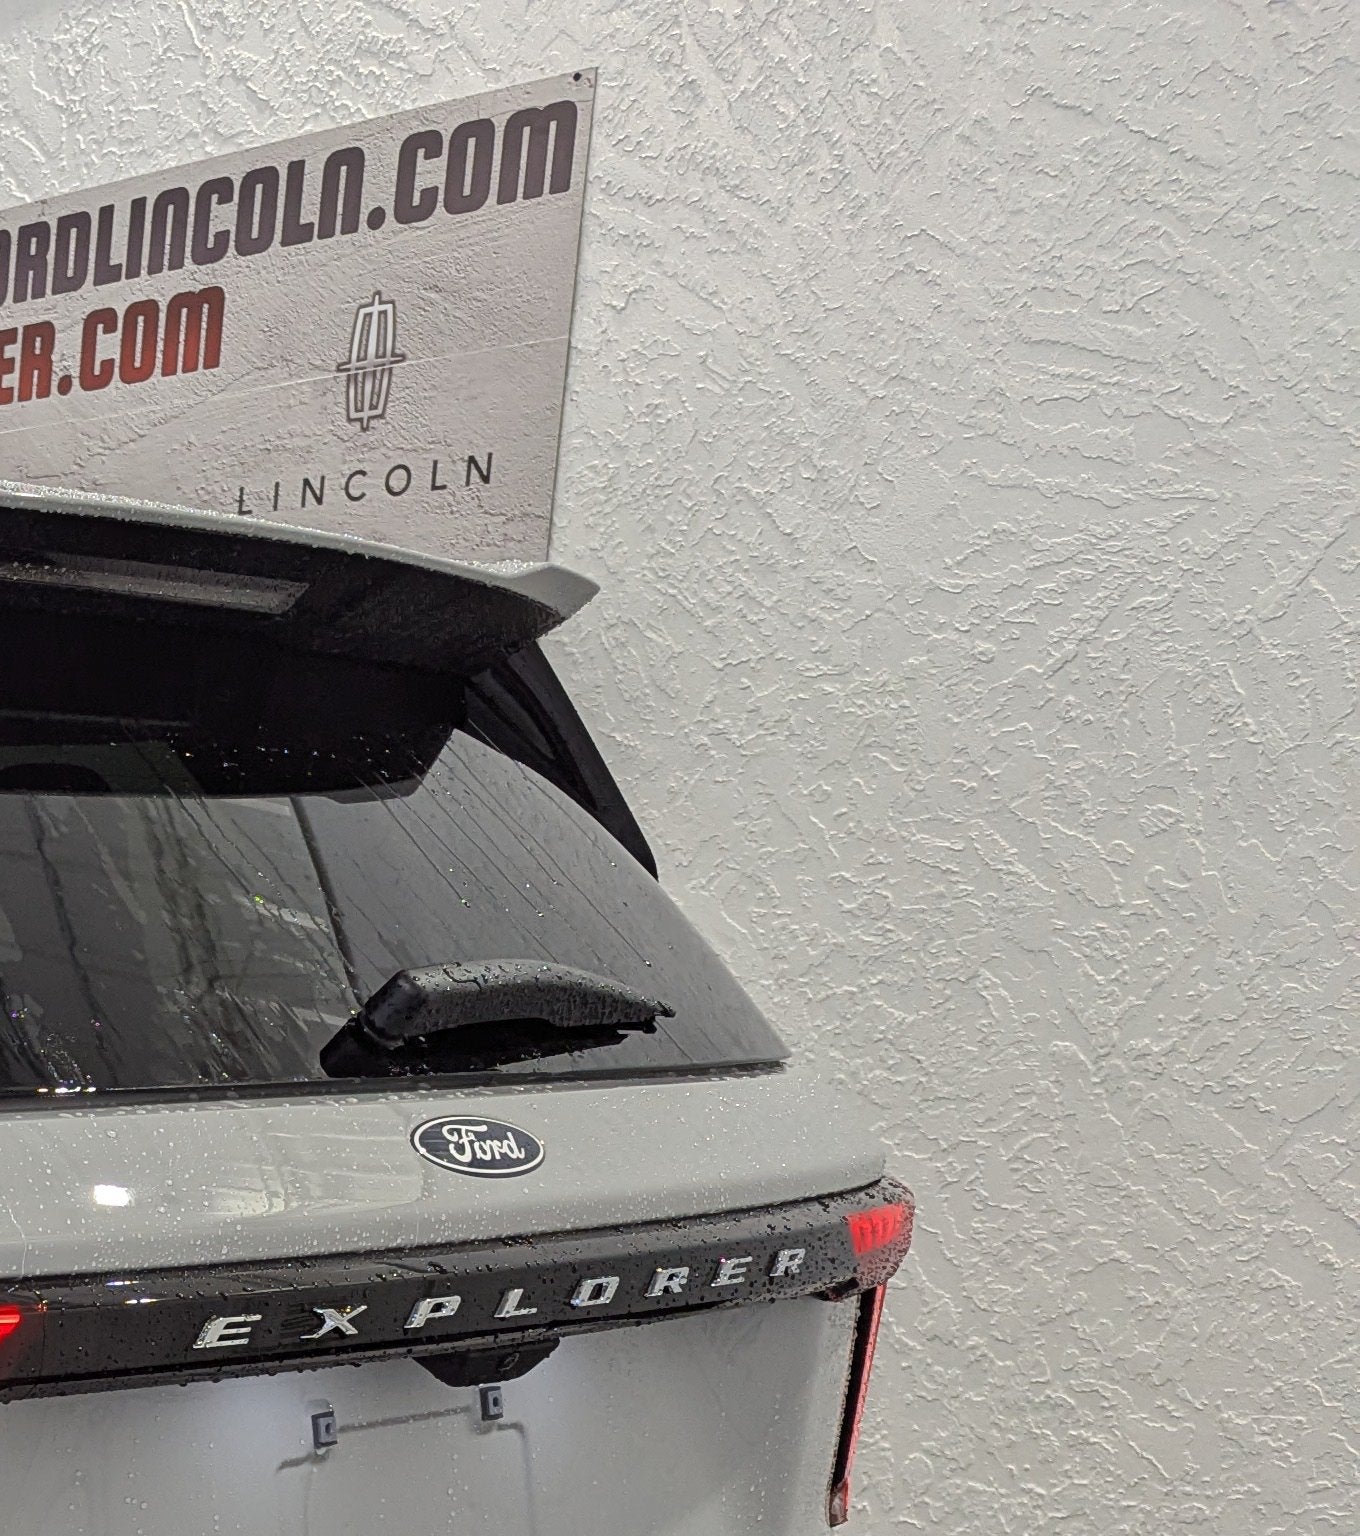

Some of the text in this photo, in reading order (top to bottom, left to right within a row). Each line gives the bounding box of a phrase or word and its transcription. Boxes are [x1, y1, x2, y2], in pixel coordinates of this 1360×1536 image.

[237, 452, 493, 516] LINCOLN
[441, 1124, 526, 1163] Ford
[192, 1247, 806, 1349] EXPLORER
